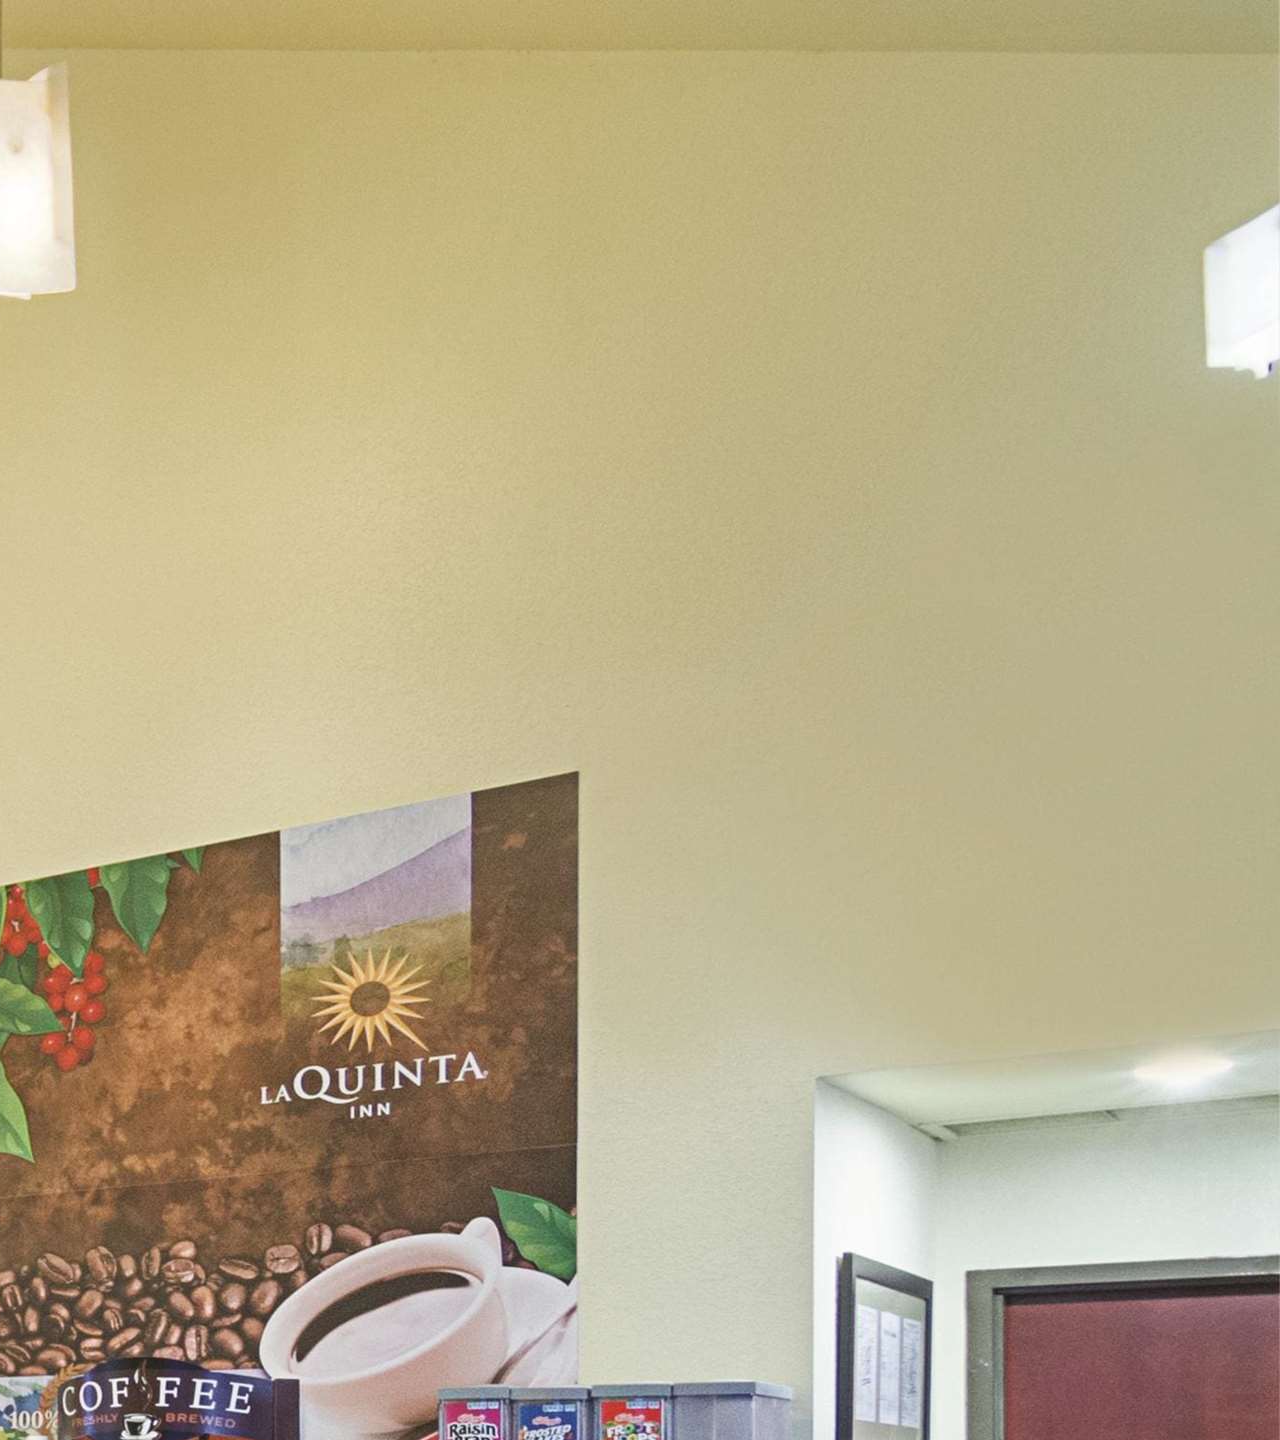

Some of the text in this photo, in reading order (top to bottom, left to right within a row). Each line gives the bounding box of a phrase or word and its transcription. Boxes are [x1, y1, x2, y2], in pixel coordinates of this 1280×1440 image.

[350, 1102, 391, 1120] INN
[61, 1376, 255, 1417] COFFEE
[10, 1408, 59, 1430] 100%
[71, 1412, 238, 1429] FRESHLY BREWED
[448, 1423, 497, 1438] Raisin
